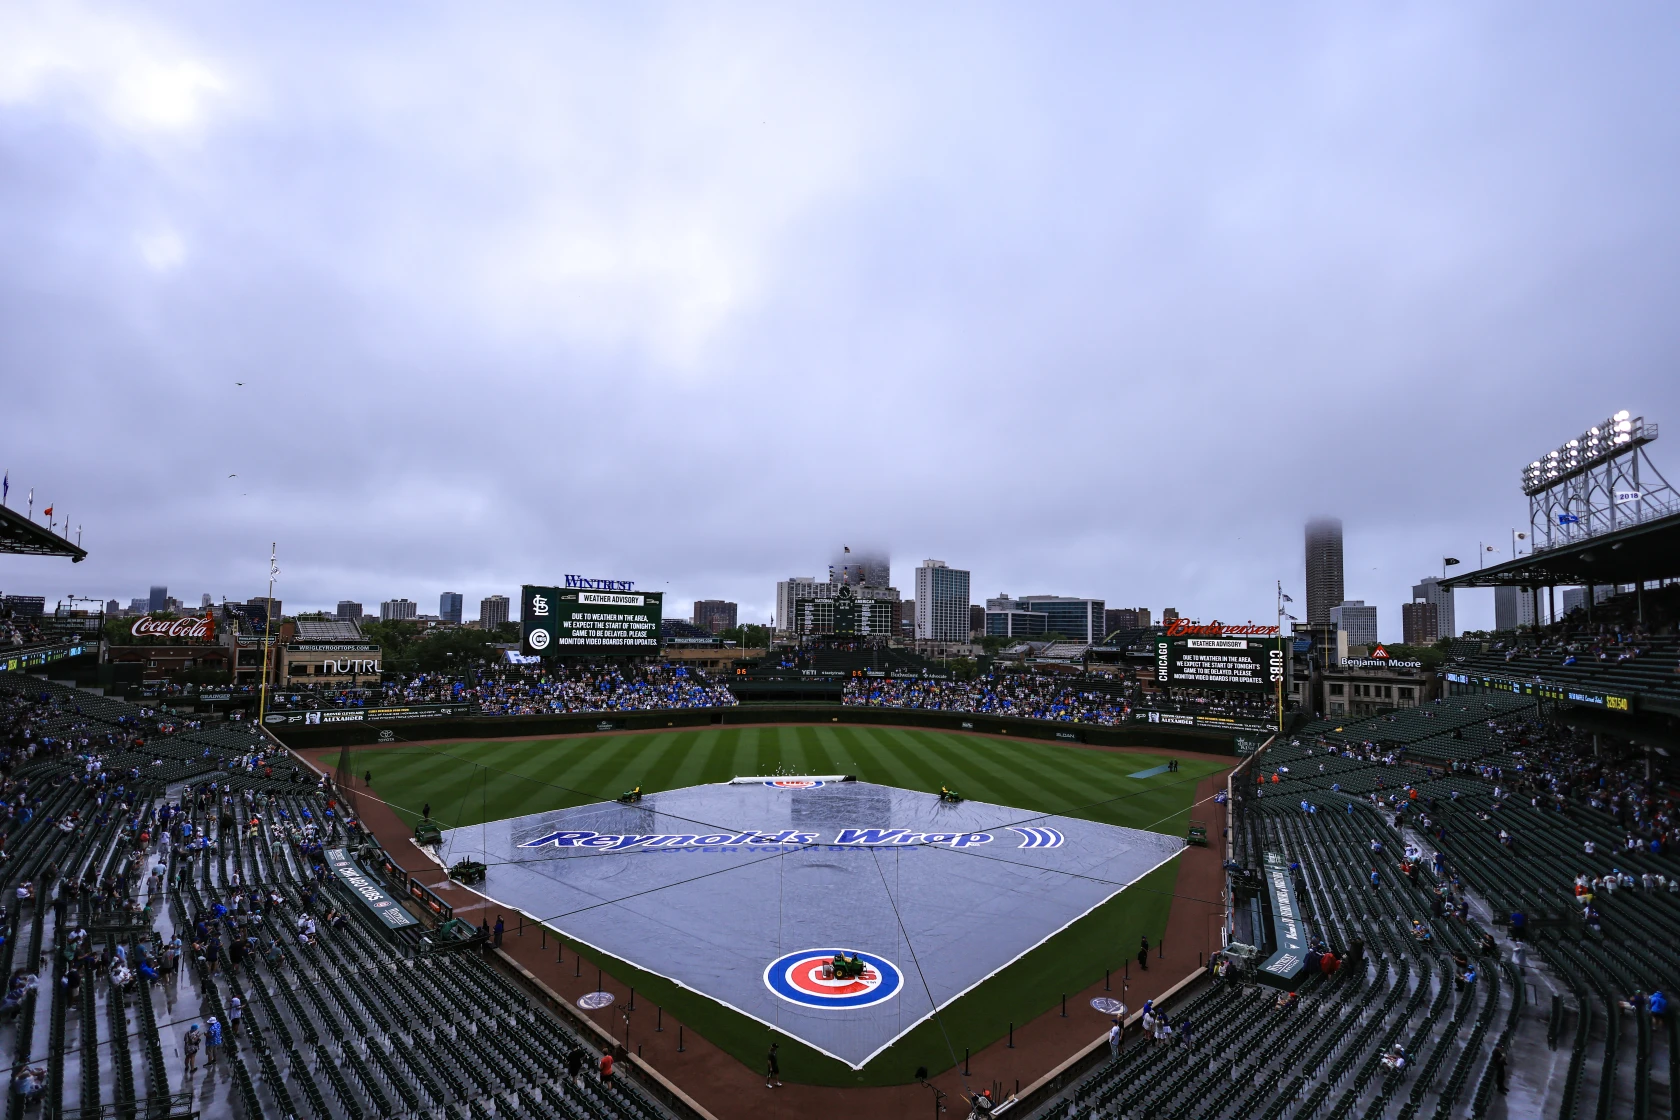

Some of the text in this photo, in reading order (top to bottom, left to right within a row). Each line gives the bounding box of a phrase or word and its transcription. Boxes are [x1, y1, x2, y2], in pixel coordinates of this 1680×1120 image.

[564, 574, 634, 591] WINTRUST
[612, 596, 639, 604] ADVISORY
[1163, 618, 1279, 636] Budweiser
[1158, 642, 1168, 682] CHICAGO
[1270, 650, 1283, 682] CUBS
[1341, 658, 1385, 667] Benjamin
[1606, 695, 1627, 710] $267,540
[518, 830, 820, 850] Reynolds
[834, 828, 994, 848] Wrap
[359, 886, 383, 902] CUBS
